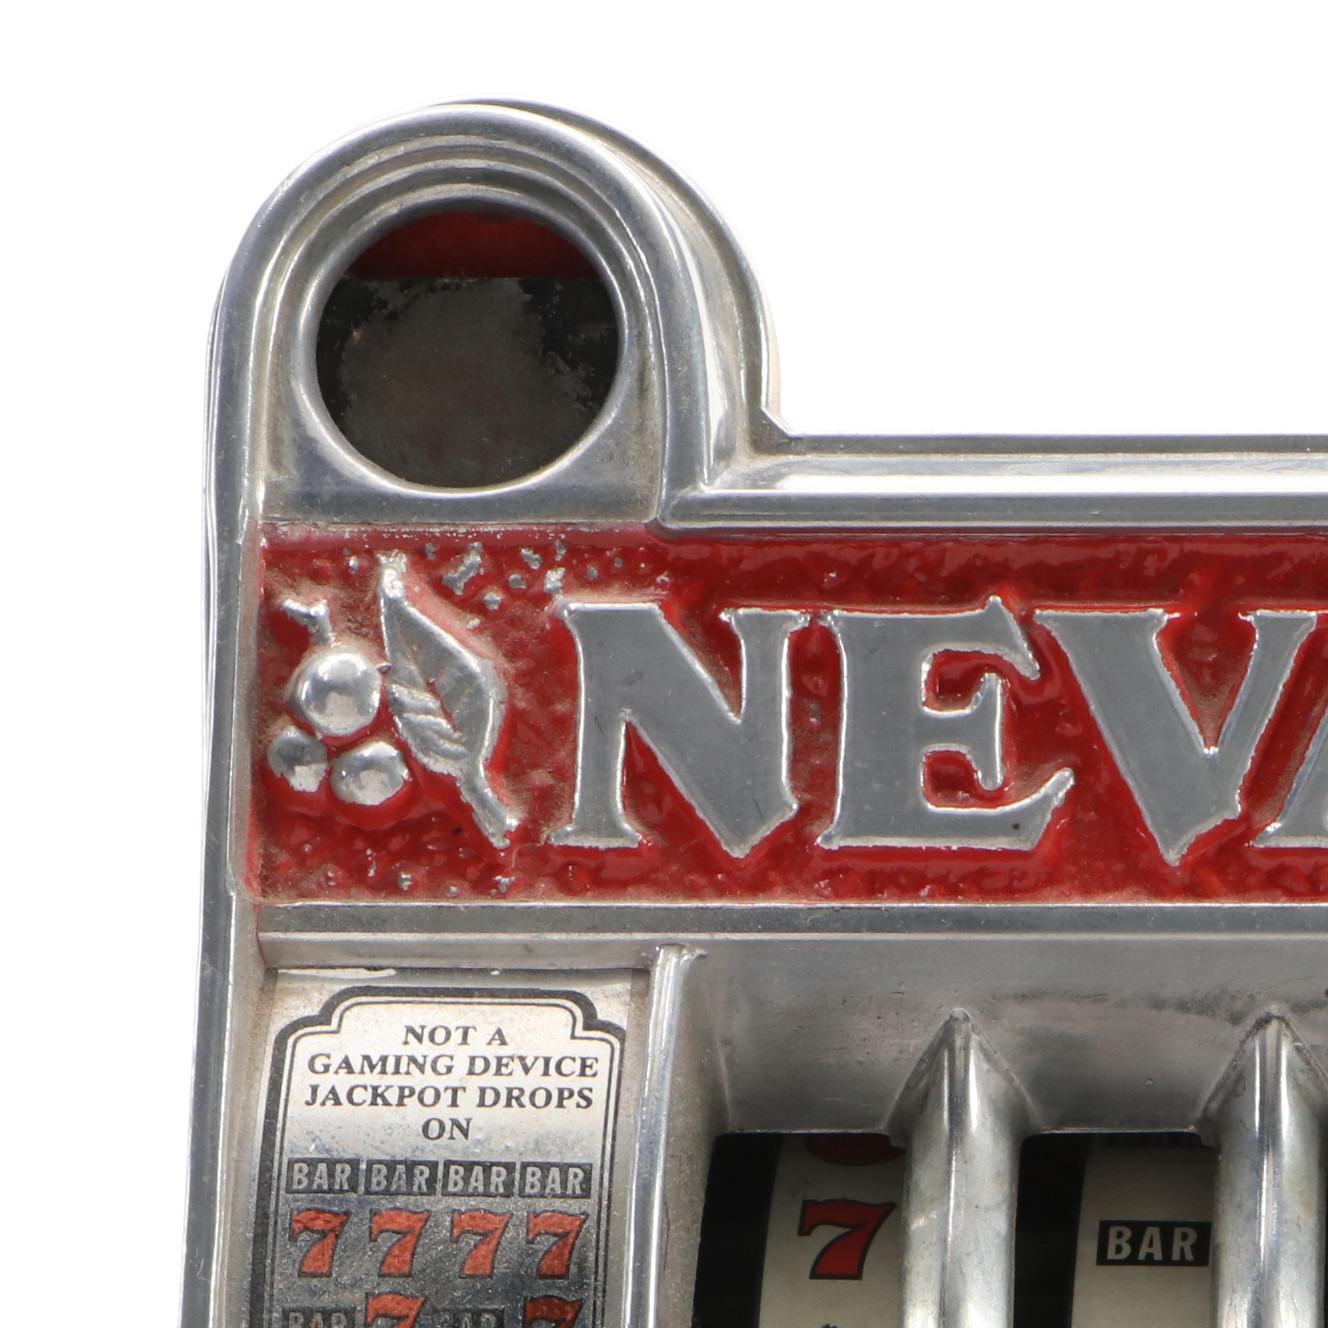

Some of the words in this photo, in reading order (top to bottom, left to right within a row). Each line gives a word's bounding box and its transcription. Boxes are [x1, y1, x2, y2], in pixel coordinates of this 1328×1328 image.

[402, 1025, 476, 1046] NOT
[486, 1027, 508, 1046] A
[308, 1054, 453, 1076] GAMING
[466, 1055, 598, 1078] DEVICE
[305, 1084, 466, 1107] JACKPOT
[476, 1086, 593, 1109] DROPS
[422, 1118, 472, 1140] ON
[291, 1162, 351, 1190] BAR
[370, 1163, 430, 1191] BAR
[448, 1165, 507, 1192] BAR
[525, 1167, 585, 1194] BAR
[288, 1208, 351, 1277] 7
[369, 1208, 431, 1277] 7
[451, 1209, 513, 1278] 7
[526, 1210, 589, 1279] 7
[797, 1198, 898, 1280] 7
[1107, 1226, 1197, 1261] BAR
